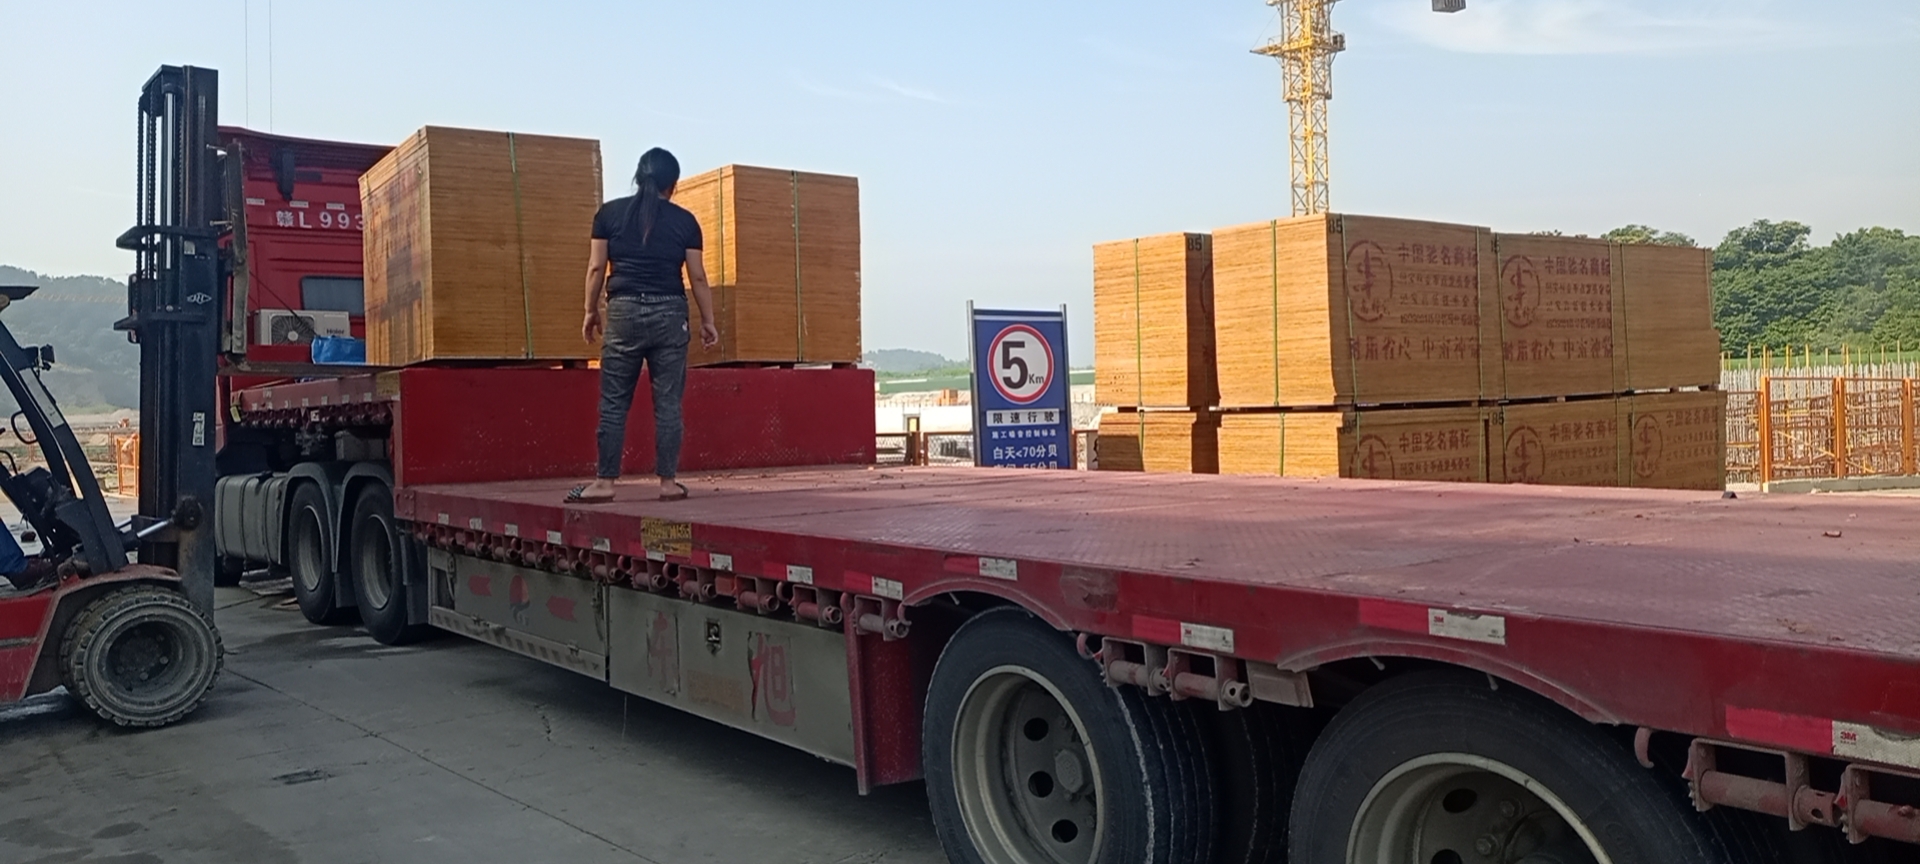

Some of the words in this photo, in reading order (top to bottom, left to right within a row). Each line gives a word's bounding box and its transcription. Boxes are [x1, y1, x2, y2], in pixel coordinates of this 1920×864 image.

[1328, 219, 1343, 234] 85
[1187, 237, 1202, 251] 85
[1002, 341, 1028, 389] 5
[1029, 373, 1045, 385] Km
[993, 411, 1055, 424] 限速行驶
[993, 444, 1058, 460] 白天<70分贝
[1840, 731, 1857, 741] 3M
